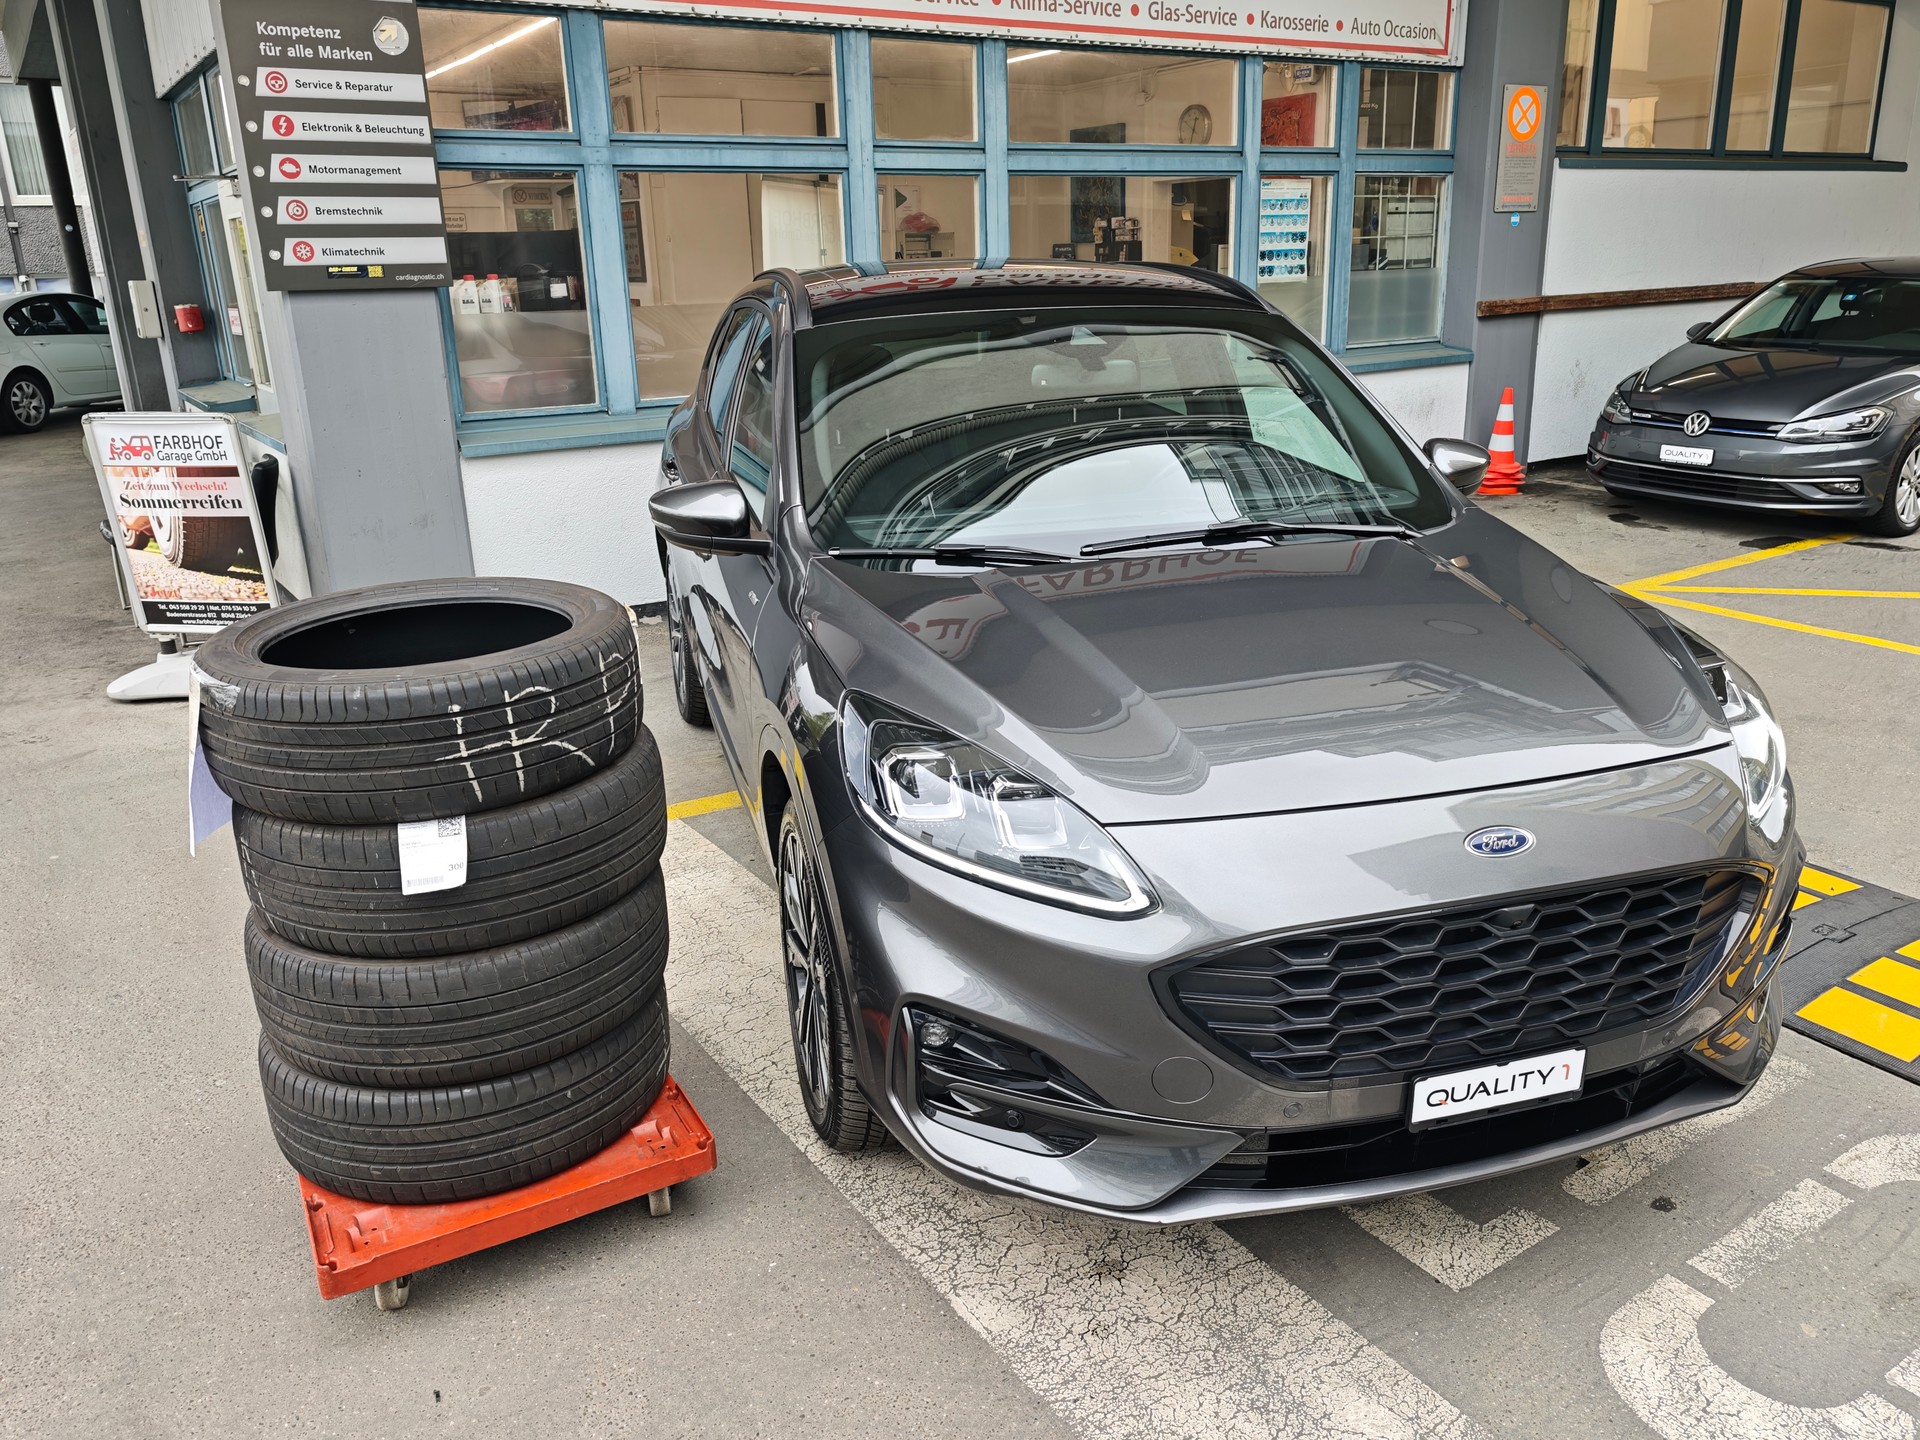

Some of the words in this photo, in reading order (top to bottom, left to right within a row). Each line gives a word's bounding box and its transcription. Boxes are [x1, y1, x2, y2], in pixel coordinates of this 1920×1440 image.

[1148, 1, 1238, 26] Glas-Service
[1260, 10, 1329, 33] Karosserie
[1351, 17, 1381, 36] Auto
[1384, 19, 1437, 41] Occasion
[256, 21, 342, 40] Kompetenz
[259, 42, 282, 57] für
[287, 44, 314, 58] alle
[318, 45, 373, 61] Marken
[295, 79, 333, 90] Service
[335, 81, 342, 90] &
[345, 81, 394, 93] Reparatur
[302, 122, 353, 133] Elektronik
[355, 124, 362, 133] &
[364, 125, 425, 137] Beleuchtung
[308, 165, 402, 176] Motormanagement
[315, 206, 384, 216] Bremstechnik
[321, 247, 386, 256] Klimatechnik
[395, 273, 445, 282] cardiagnostic.ch
[153, 435, 223, 450] FARBHOF
[157, 450, 193, 464] Garage
[195, 450, 228, 461] GmbH
[1664, 449, 1704, 459] QUALITY
[123, 481, 146, 491] Zeit
[171, 480, 228, 491] Wechseln!
[119, 493, 243, 509] Sommerreifen
[1482, 832, 1519, 852] Ford
[448, 862, 464, 872] 300
[1426, 1066, 1556, 1108] QUALITY
[1562, 1063, 1570, 1081] 1
